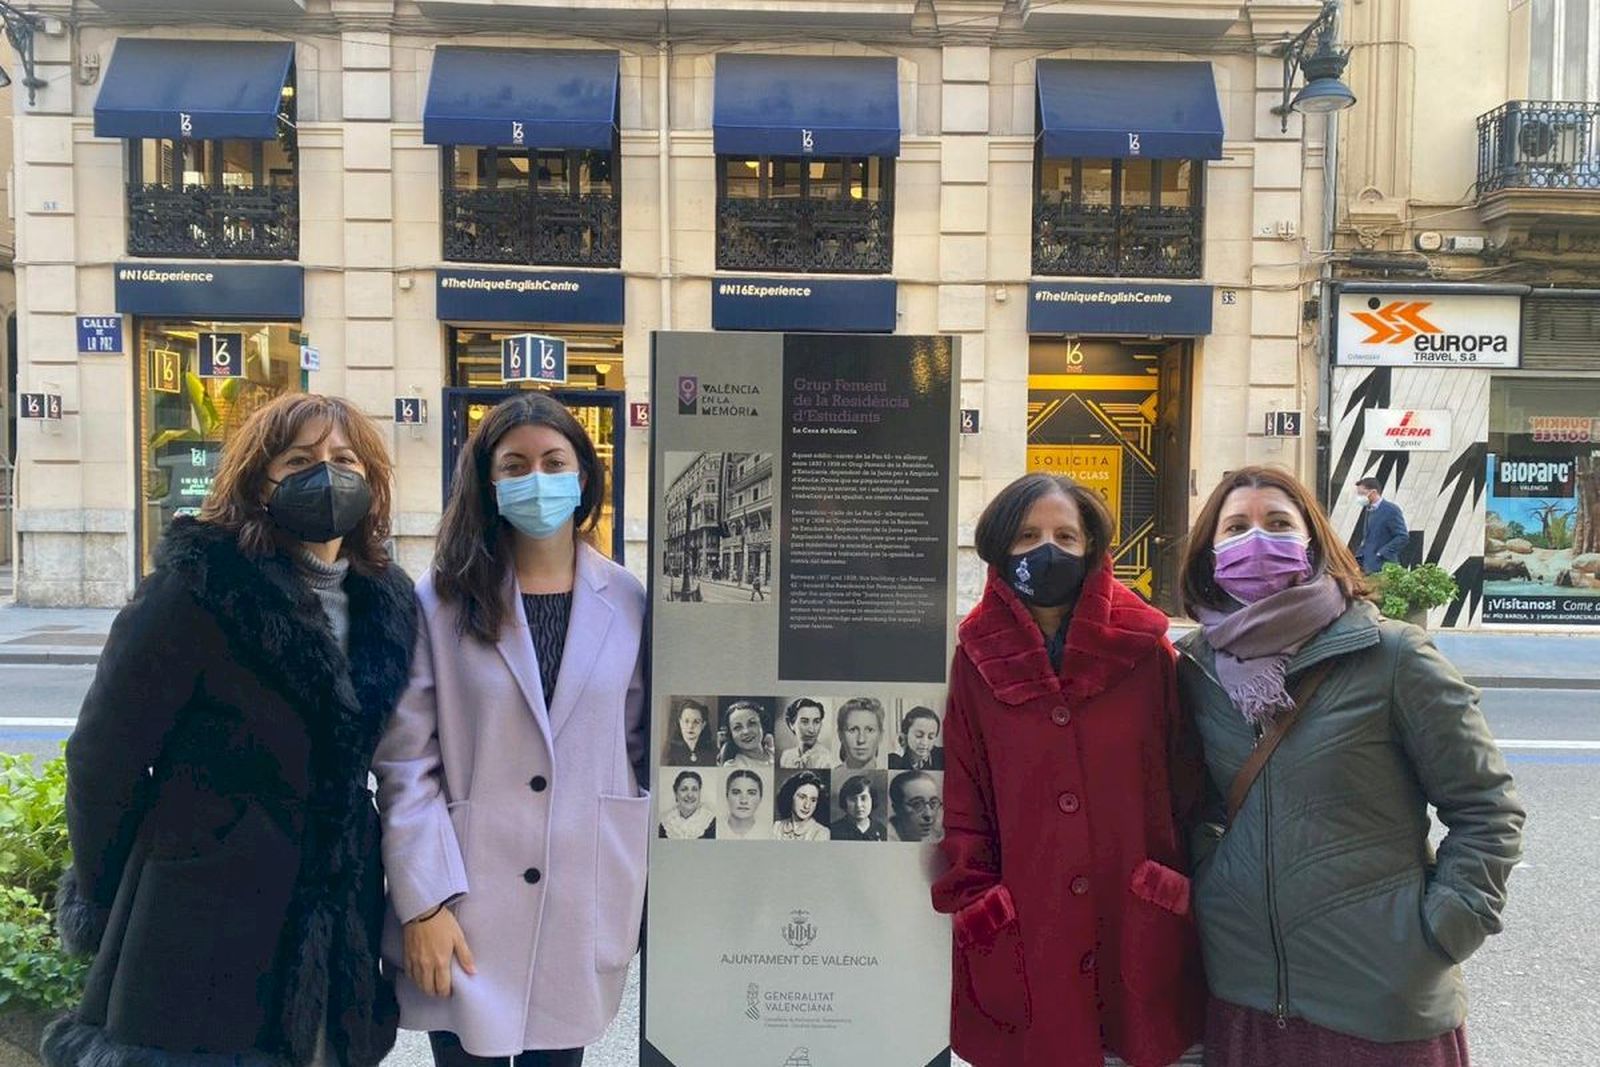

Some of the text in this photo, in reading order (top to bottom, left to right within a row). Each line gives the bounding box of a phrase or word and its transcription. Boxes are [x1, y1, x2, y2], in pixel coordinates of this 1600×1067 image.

[119, 269, 214, 283] #N16Experience
[441, 277, 580, 293] #TheUniqueEnglishCentre
[719, 284, 812, 298] #N16Experience
[1035, 290, 1172, 304] #TheUniqueEnglishCentre
[83, 318, 116, 329] CALLE
[87, 336, 113, 351] LA PAZ
[209, 334, 231, 366] 16
[539, 340, 556, 371] 16
[1066, 339, 1084, 365] 16
[793, 378, 831, 394] Grup
[792, 394, 812, 407] de
[815, 394, 829, 407] la
[792, 410, 881, 423] d'Estudiants
[1385, 427, 1433, 437] IBERIA
[1393, 439, 1422, 448] Agente
[1034, 456, 1109, 465] SOLICITA
[1079, 471, 1109, 480] CLASS
[1563, 600, 1593, 611] Come
[721, 954, 799, 965] AJUNTAMENT
[802, 955, 818, 965] DE
[764, 991, 834, 1001] GENERALITAT
[765, 1002, 834, 1012] VALENCIANA
